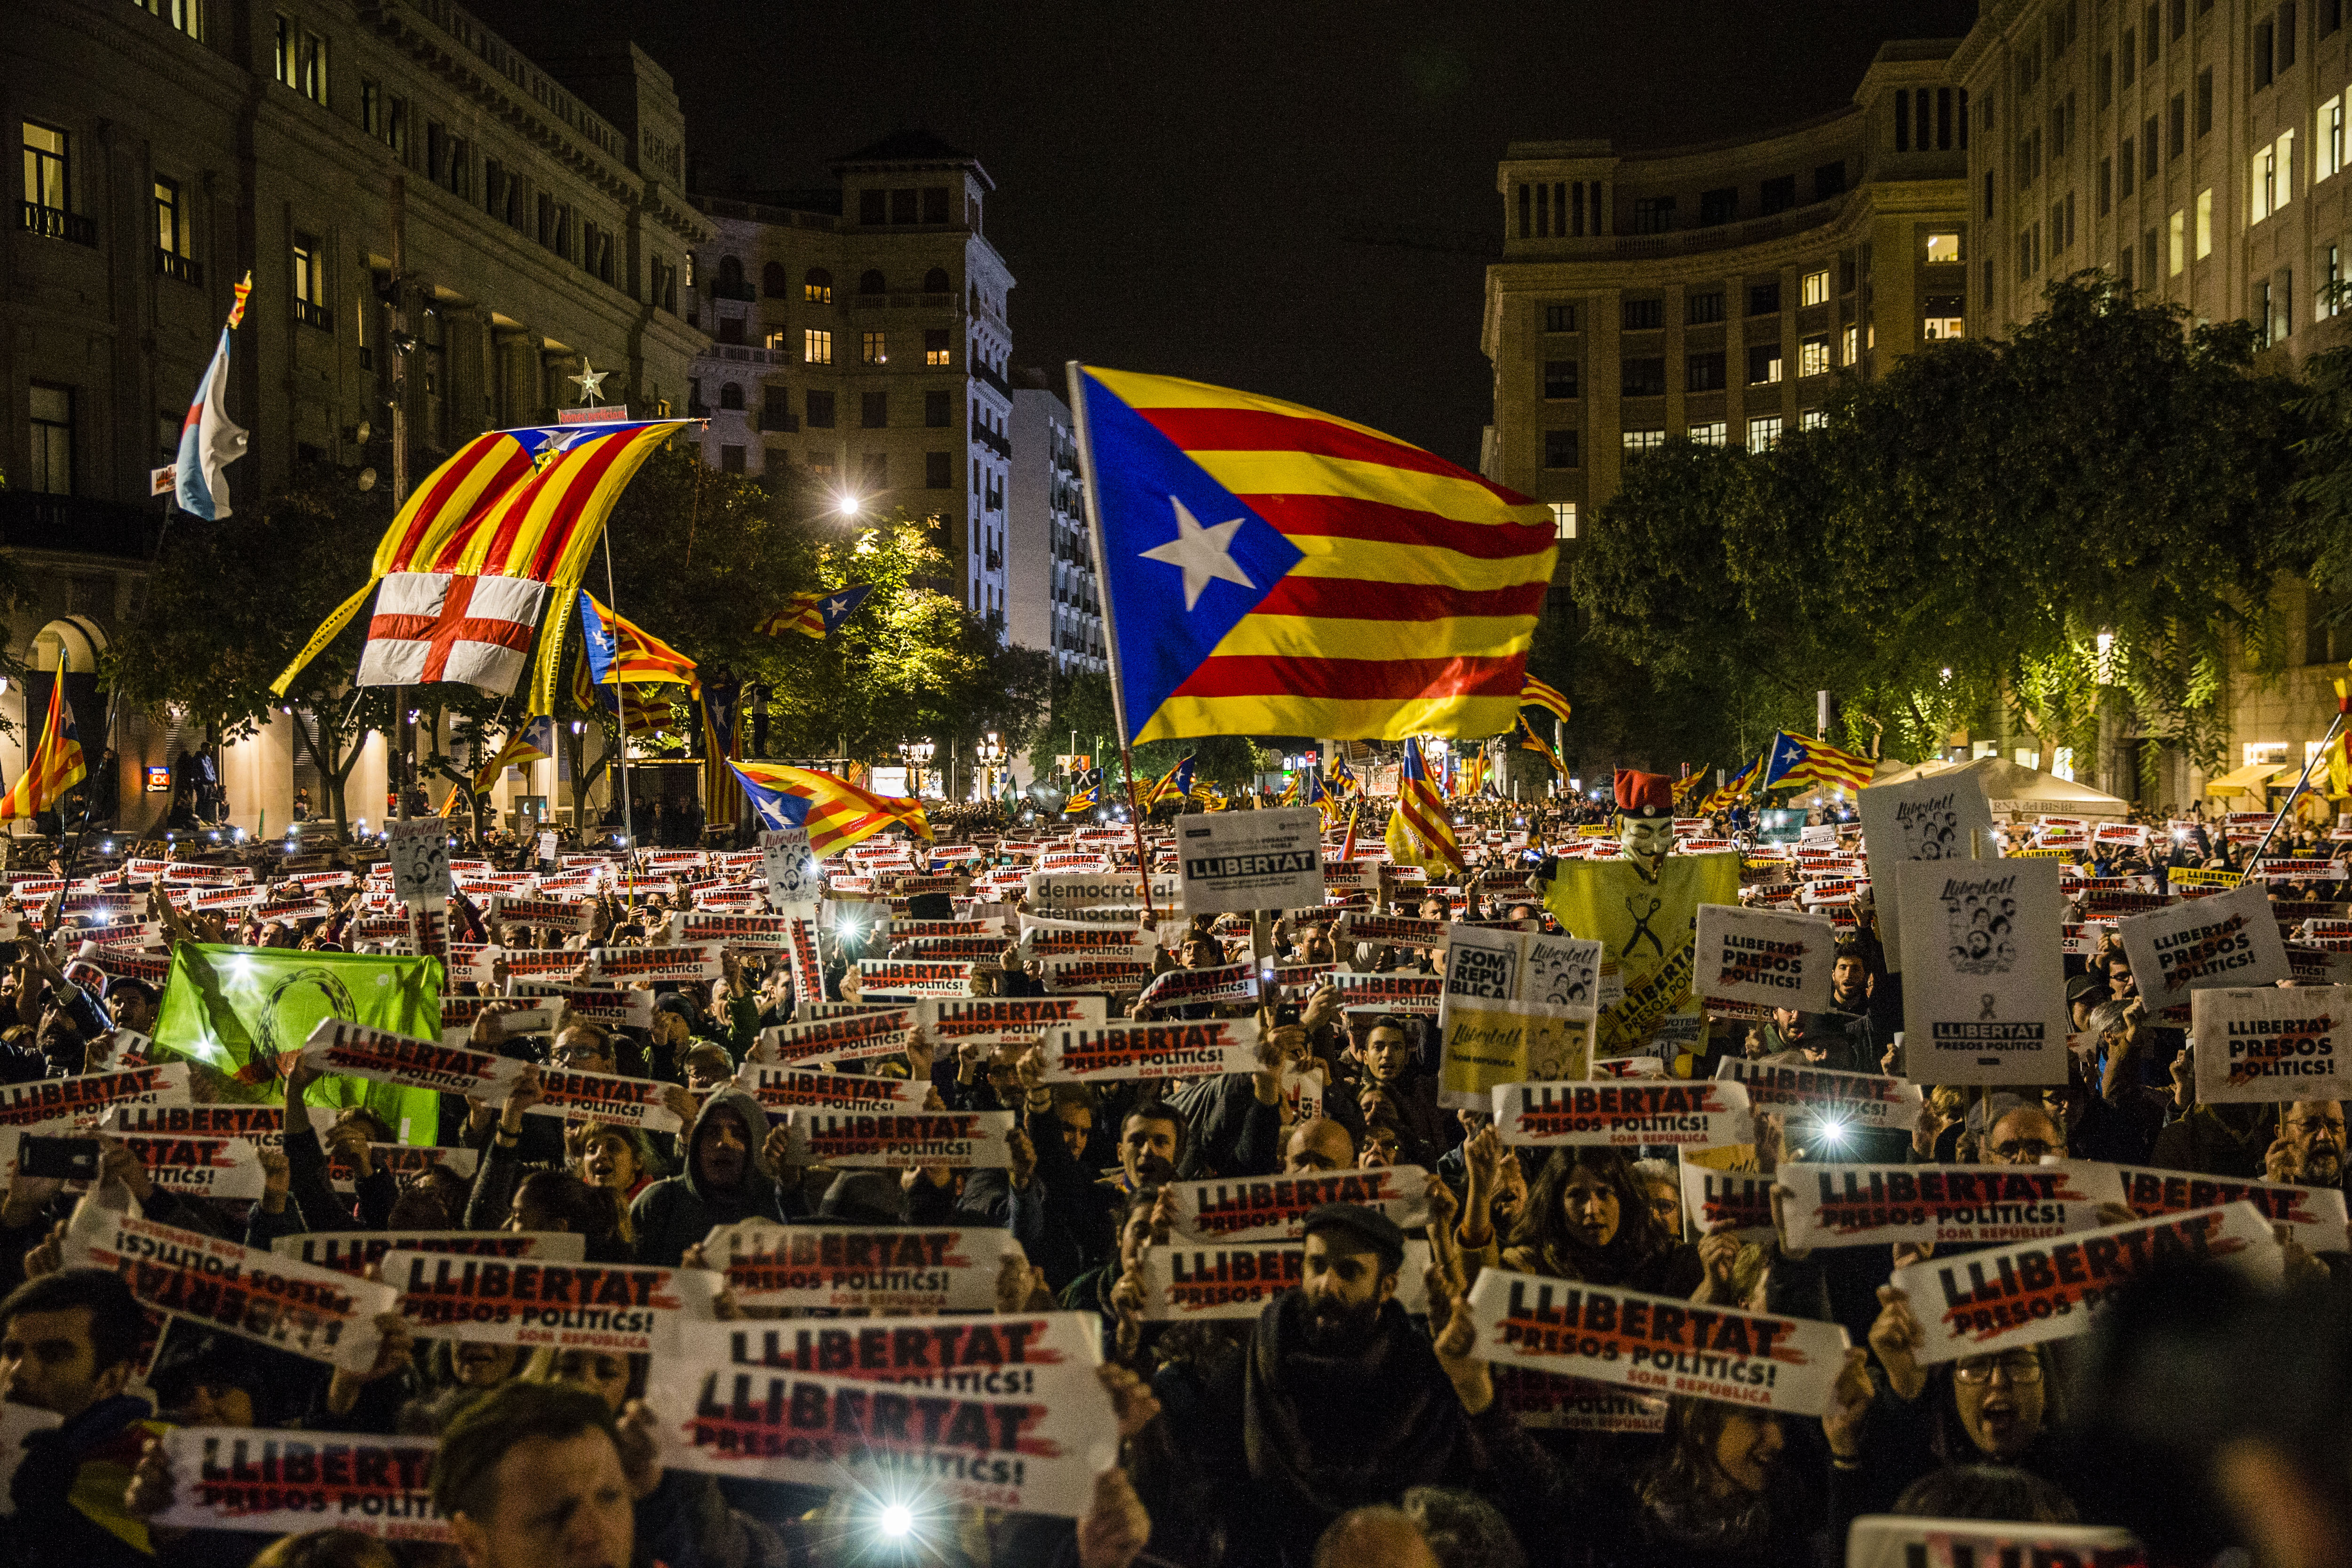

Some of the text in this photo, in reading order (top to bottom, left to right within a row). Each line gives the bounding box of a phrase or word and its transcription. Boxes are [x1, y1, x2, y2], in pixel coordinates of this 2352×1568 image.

[152, 775, 166, 784] CX
[1192, 852, 1311, 877] LLIBERTAT
[2263, 860, 2332, 868] LLIBERTAT
[197, 886, 258, 900] LLIBERTAT
[1941, 876, 2015, 900] Llibertat!
[501, 899, 580, 917] LLIBERTAT
[65, 925, 142, 943] LLIBERTAT
[683, 916, 782, 933] LLIBERTAT
[889, 921, 982, 936] LLIBERTAT
[1351, 916, 1447, 933] LLIBERTAT
[2153, 916, 2242, 951] LLIBERTAT
[914, 939, 1007, 954] LLIBERTAT
[1033, 930, 1136, 946] LLIBERTAT
[1724, 934, 1804, 957] LLIBERTAT
[600, 948, 702, 965] LLIBERTAT
[2157, 932, 2250, 969] PRESOS
[862, 963, 963, 980] LLIBERTAT
[938, 1001, 1072, 1022] LLIBERTAT
[778, 1011, 902, 1045] LLIBERTAT
[1062, 1023, 1224, 1051] LLIBERTAT
[1936, 1024, 2042, 1038] LLIBERTAT
[2228, 1018, 2331, 1036] LLIBERTAT
[2229, 1037, 2333, 1057] PRESOS
[759, 1069, 896, 1101] LLIBERTAT
[1522, 1086, 1709, 1114] LLIBERTAT
[811, 1116, 971, 1140] LLIBERTAT
[1819, 1171, 2060, 1204] LLIBERTAT
[1823, 1207, 1925, 1227] PRESOS
[731, 1233, 946, 1267] LLIBERTAT
[407, 1257, 661, 1307] LLIBERTAT
[1170, 1285, 1261, 1304] PRESOS
[1509, 1281, 1783, 1358] LLIBERTAT
[1954, 1292, 2075, 1335] PRESOS
[732, 1322, 1037, 1370] LLIBERTAT
[1507, 1323, 1619, 1361] PRESOS
